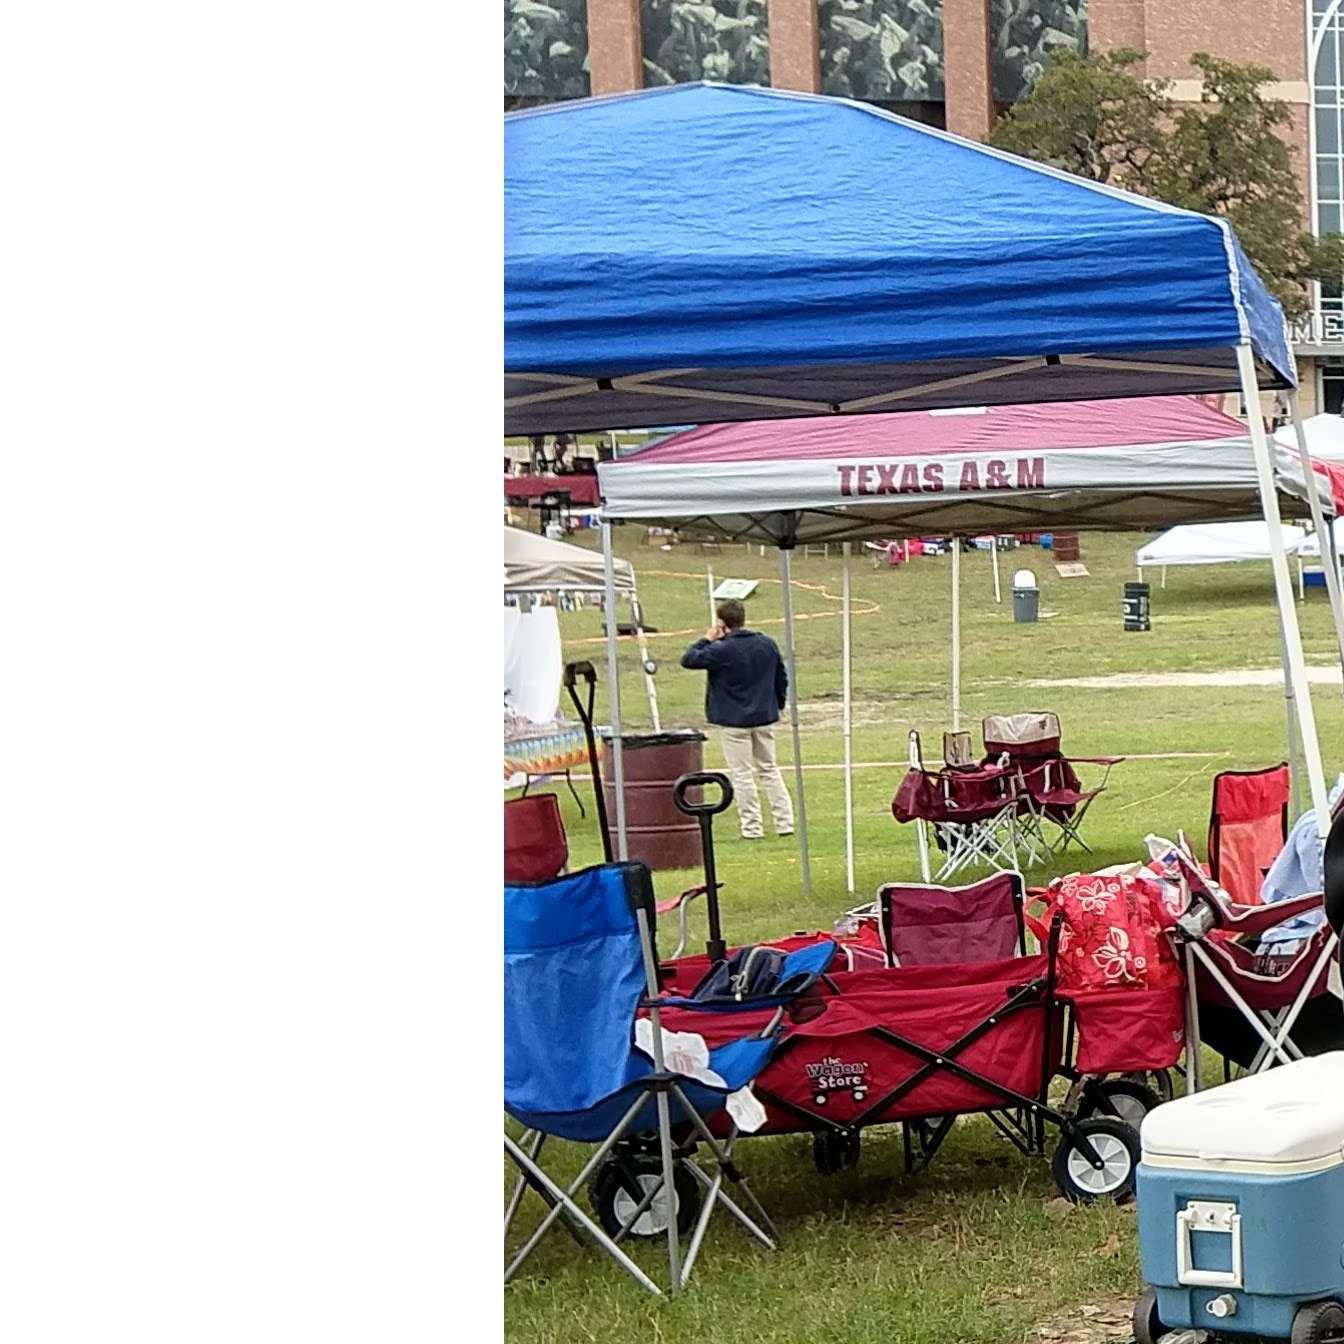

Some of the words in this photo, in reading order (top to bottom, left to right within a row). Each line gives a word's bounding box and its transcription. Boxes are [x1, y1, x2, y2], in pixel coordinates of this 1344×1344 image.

[837, 462, 945, 497] TEXAS
[959, 457, 1045, 492] A&M
[822, 1057, 842, 1066] the
[804, 1063, 865, 1078] Wagon
[818, 1076, 862, 1089] Store
